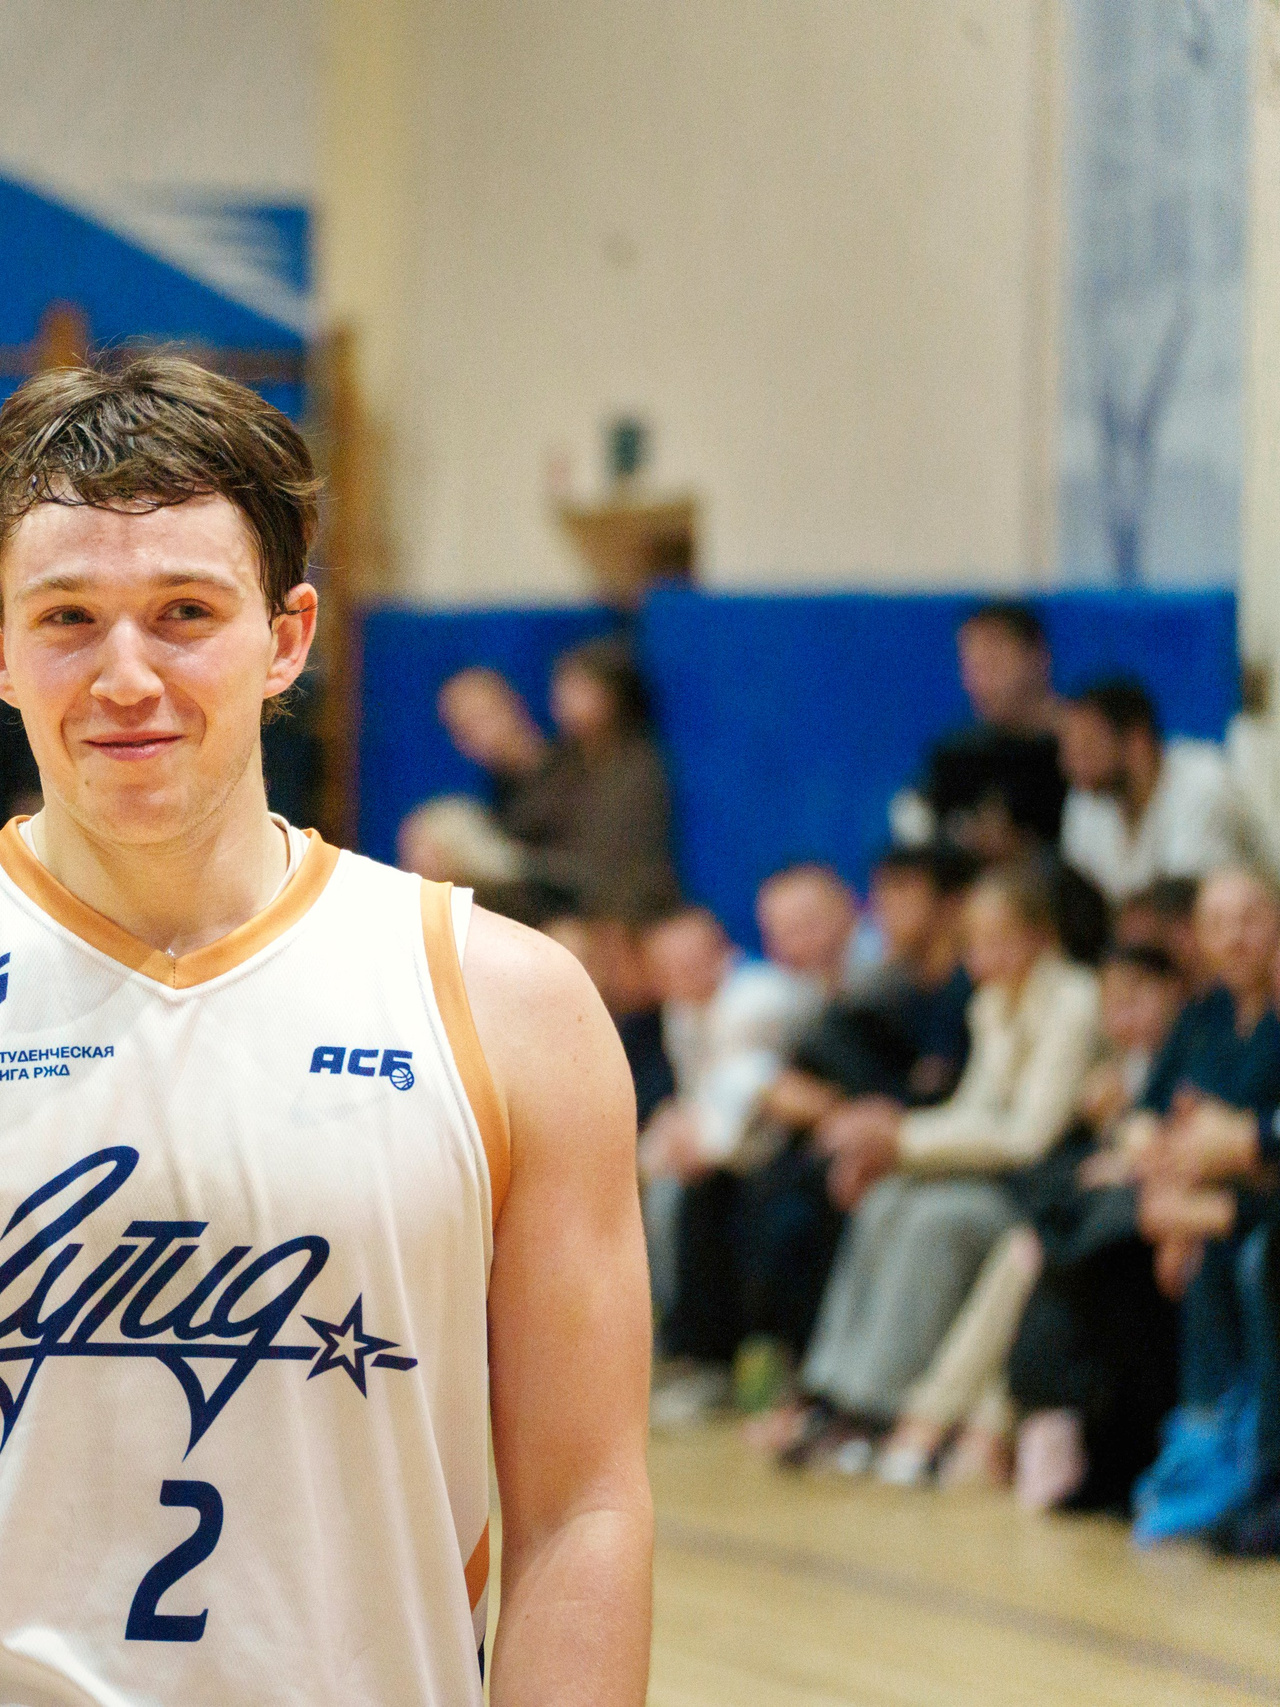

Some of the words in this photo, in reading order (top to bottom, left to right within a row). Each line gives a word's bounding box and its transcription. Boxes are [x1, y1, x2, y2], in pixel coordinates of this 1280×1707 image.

[33, 1063, 71, 1080] РЖД
[309, 1046, 414, 1086] АСБ
[124, 1479, 224, 1643] 2
